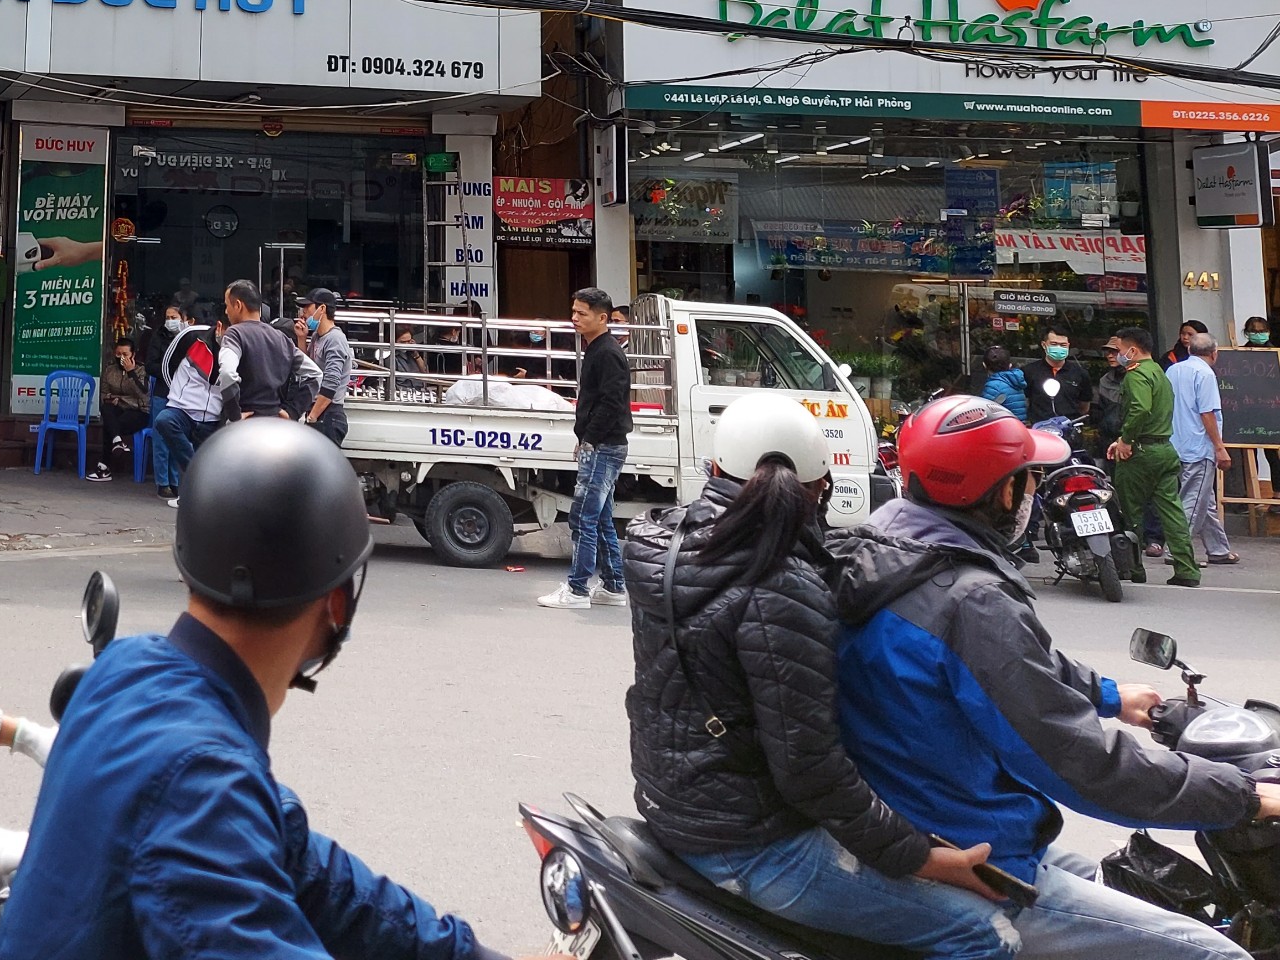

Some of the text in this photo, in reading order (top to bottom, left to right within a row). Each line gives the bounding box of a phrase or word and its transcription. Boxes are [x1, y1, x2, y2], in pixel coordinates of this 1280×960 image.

[327, 54, 485, 80] ĐT: 0904.324 679
[671, 93, 689, 103] 441
[691, 93, 703, 103] Lê
[763, 94, 776, 104] Q.
[778, 94, 800, 107] Ngô
[855, 95, 873, 108] Hải
[877, 97, 912, 111] Phòng
[35, 137, 96, 153] ĐỨC HUY
[500, 178, 552, 193] MAI'S
[35, 192, 92, 209] ĐỀ MÁY
[512, 197, 541, 211] NHUỘM
[23, 207, 99, 223] VỌT NGAY
[455, 244, 484, 263] BẢO
[450, 279, 489, 298] HÀNH
[1184, 271, 1219, 290] 441
[23, 289, 93, 309] 3 THÁNG
[17, 387, 37, 397] FE
[429, 428, 543, 451] 15C-029.42
[834, 485, 858, 496] 500kg
[841, 500, 852, 508] 2N
